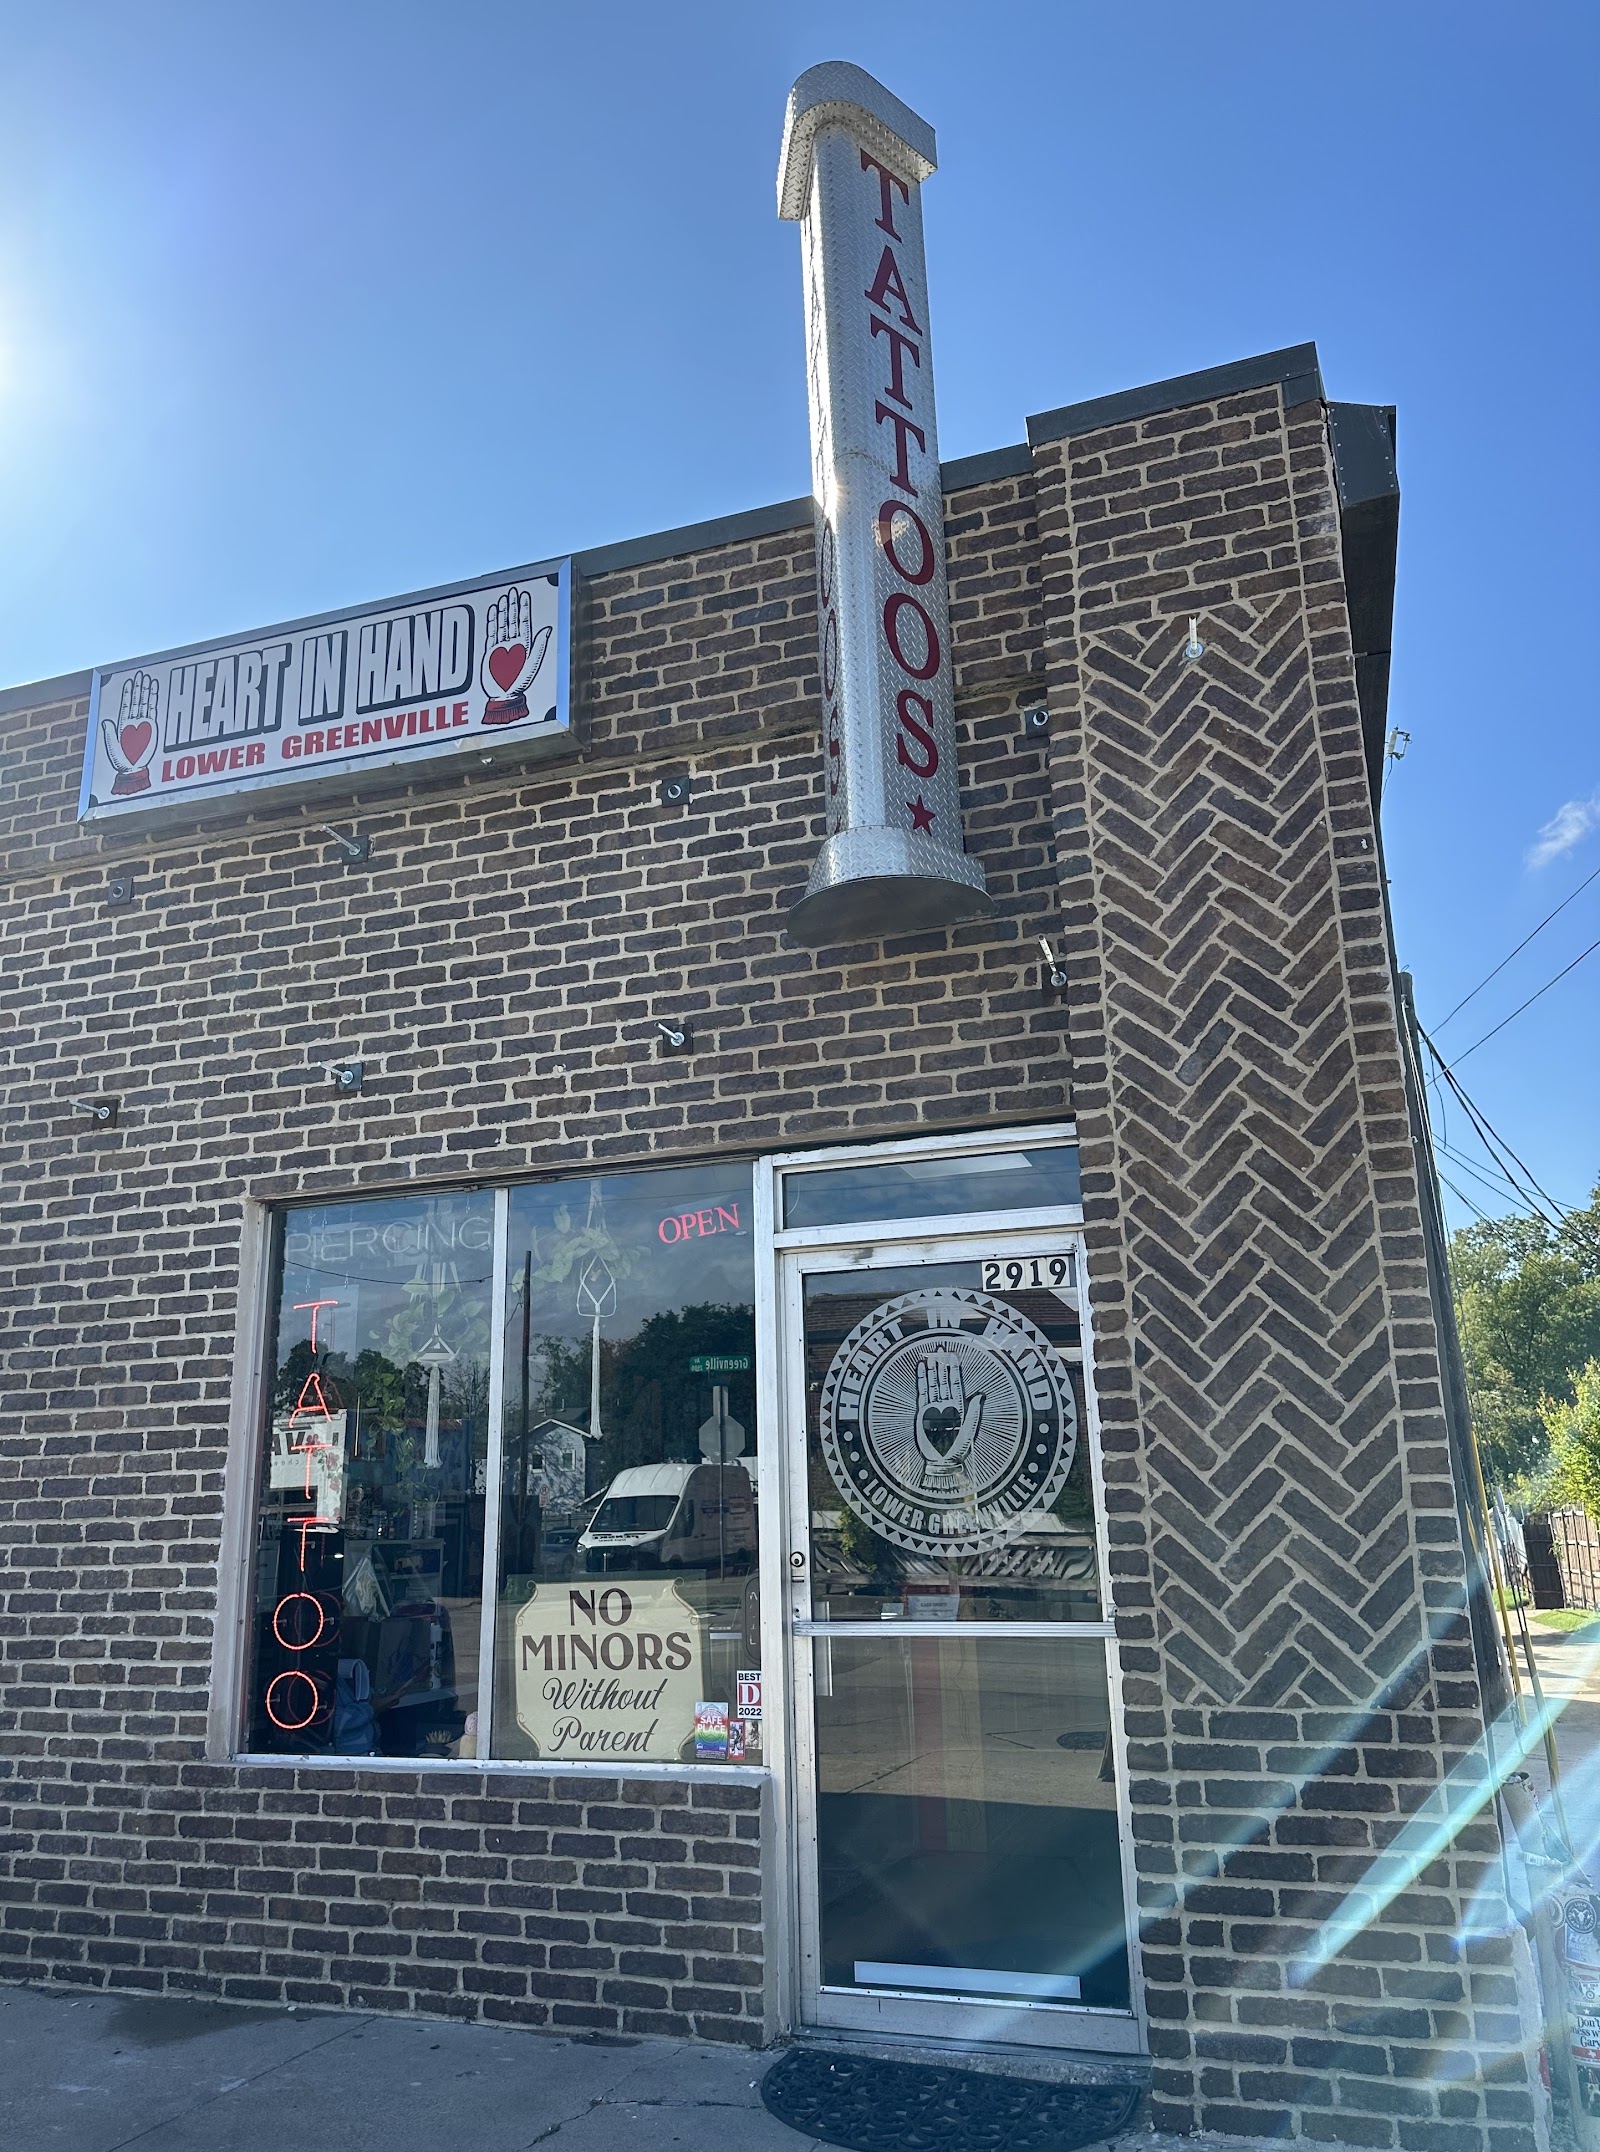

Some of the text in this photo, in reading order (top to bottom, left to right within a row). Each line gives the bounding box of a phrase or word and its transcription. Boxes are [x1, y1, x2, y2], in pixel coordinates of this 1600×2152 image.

[860, 149, 940, 779] TATTOOS
[164, 604, 476, 753] HEART IN HAND
[161, 701, 470, 783] LOWER GREENVILLE
[285, 1216, 492, 1262] PIERCING
[658, 1203, 739, 1244] OPEN
[984, 1258, 1067, 1289] 2919
[838, 1307, 1054, 1421] HEART IN HAND
[265, 1300, 340, 1729] TATTOO
[863, 1472, 1039, 1536] LOWER GREENVILLE
[569, 1587, 633, 1627] NO
[521, 1631, 692, 1671] MINORS
[542, 1677, 669, 1711] Without
[738, 1672, 761, 1681] BEST
[697, 1723, 726, 1734] PLACE
[700, 1715, 723, 1725] SAFE
[738, 1707, 762, 1716] 2022
[548, 1716, 660, 1752] Parent
